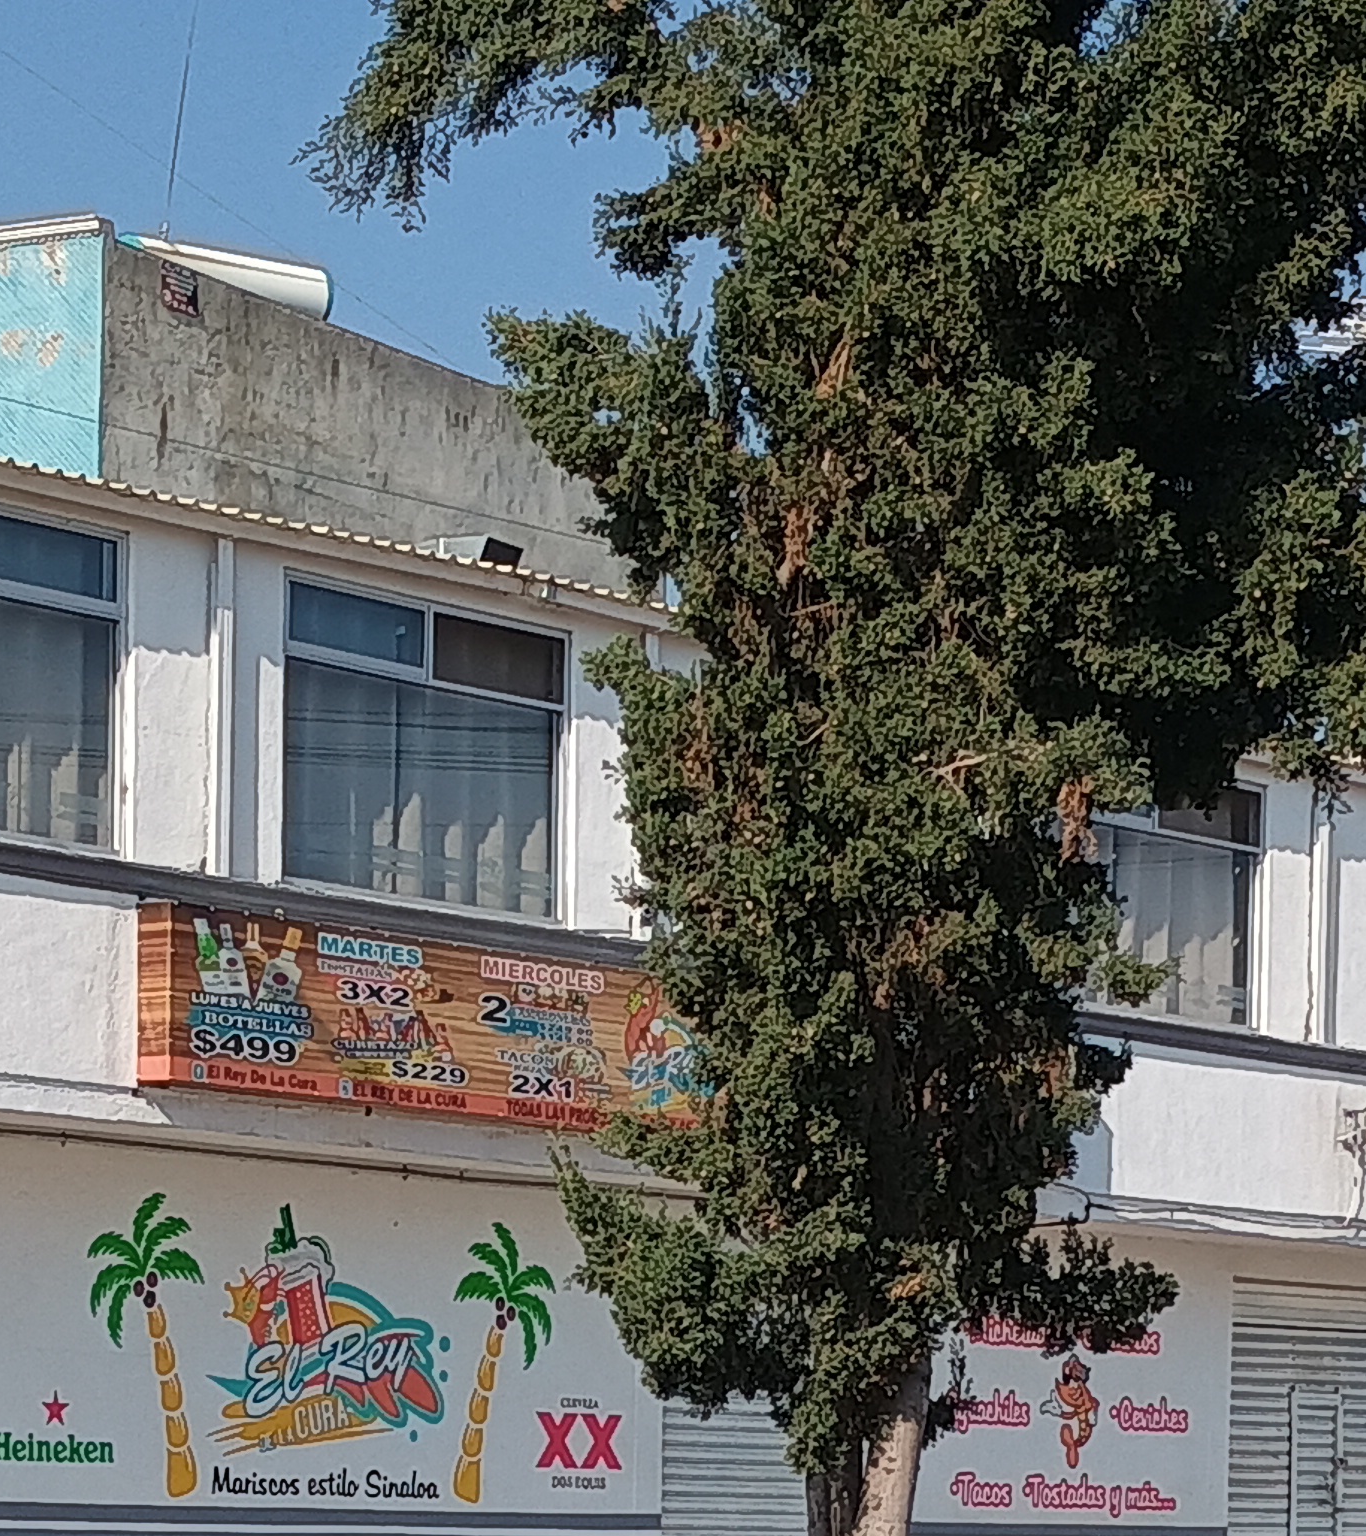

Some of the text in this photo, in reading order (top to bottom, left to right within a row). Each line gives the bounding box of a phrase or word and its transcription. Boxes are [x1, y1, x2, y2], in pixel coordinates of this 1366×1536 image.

[319, 937, 421, 966] MARTES
[483, 958, 603, 993] MIERCOLES
[191, 991, 239, 1008] LUNES
[254, 1001, 309, 1018] JUEVES
[339, 979, 411, 1008] 3X2
[204, 1011, 313, 1038] BOTELLAS
[480, 995, 508, 1025] 2
[192, 1028, 297, 1064] $499
[270, 1070, 285, 1087] La
[391, 1060, 467, 1085] $229
[511, 1074, 572, 1099] 2X1
[353, 1080, 468, 1109] EL REY DE LA CURA
[244, 1320, 413, 1418] El Rey
[294, 1398, 349, 1440] CURA
[1119, 1395, 1189, 1434] Ceviches
[535, 1411, 622, 1470] XX
[211, 1465, 440, 1500] Mariscos estilo Sinaloa
[955, 1471, 1013, 1508] Tacos
[1027, 1472, 1106, 1510] Tostadas
[1109, 1485, 1122, 1519] y
